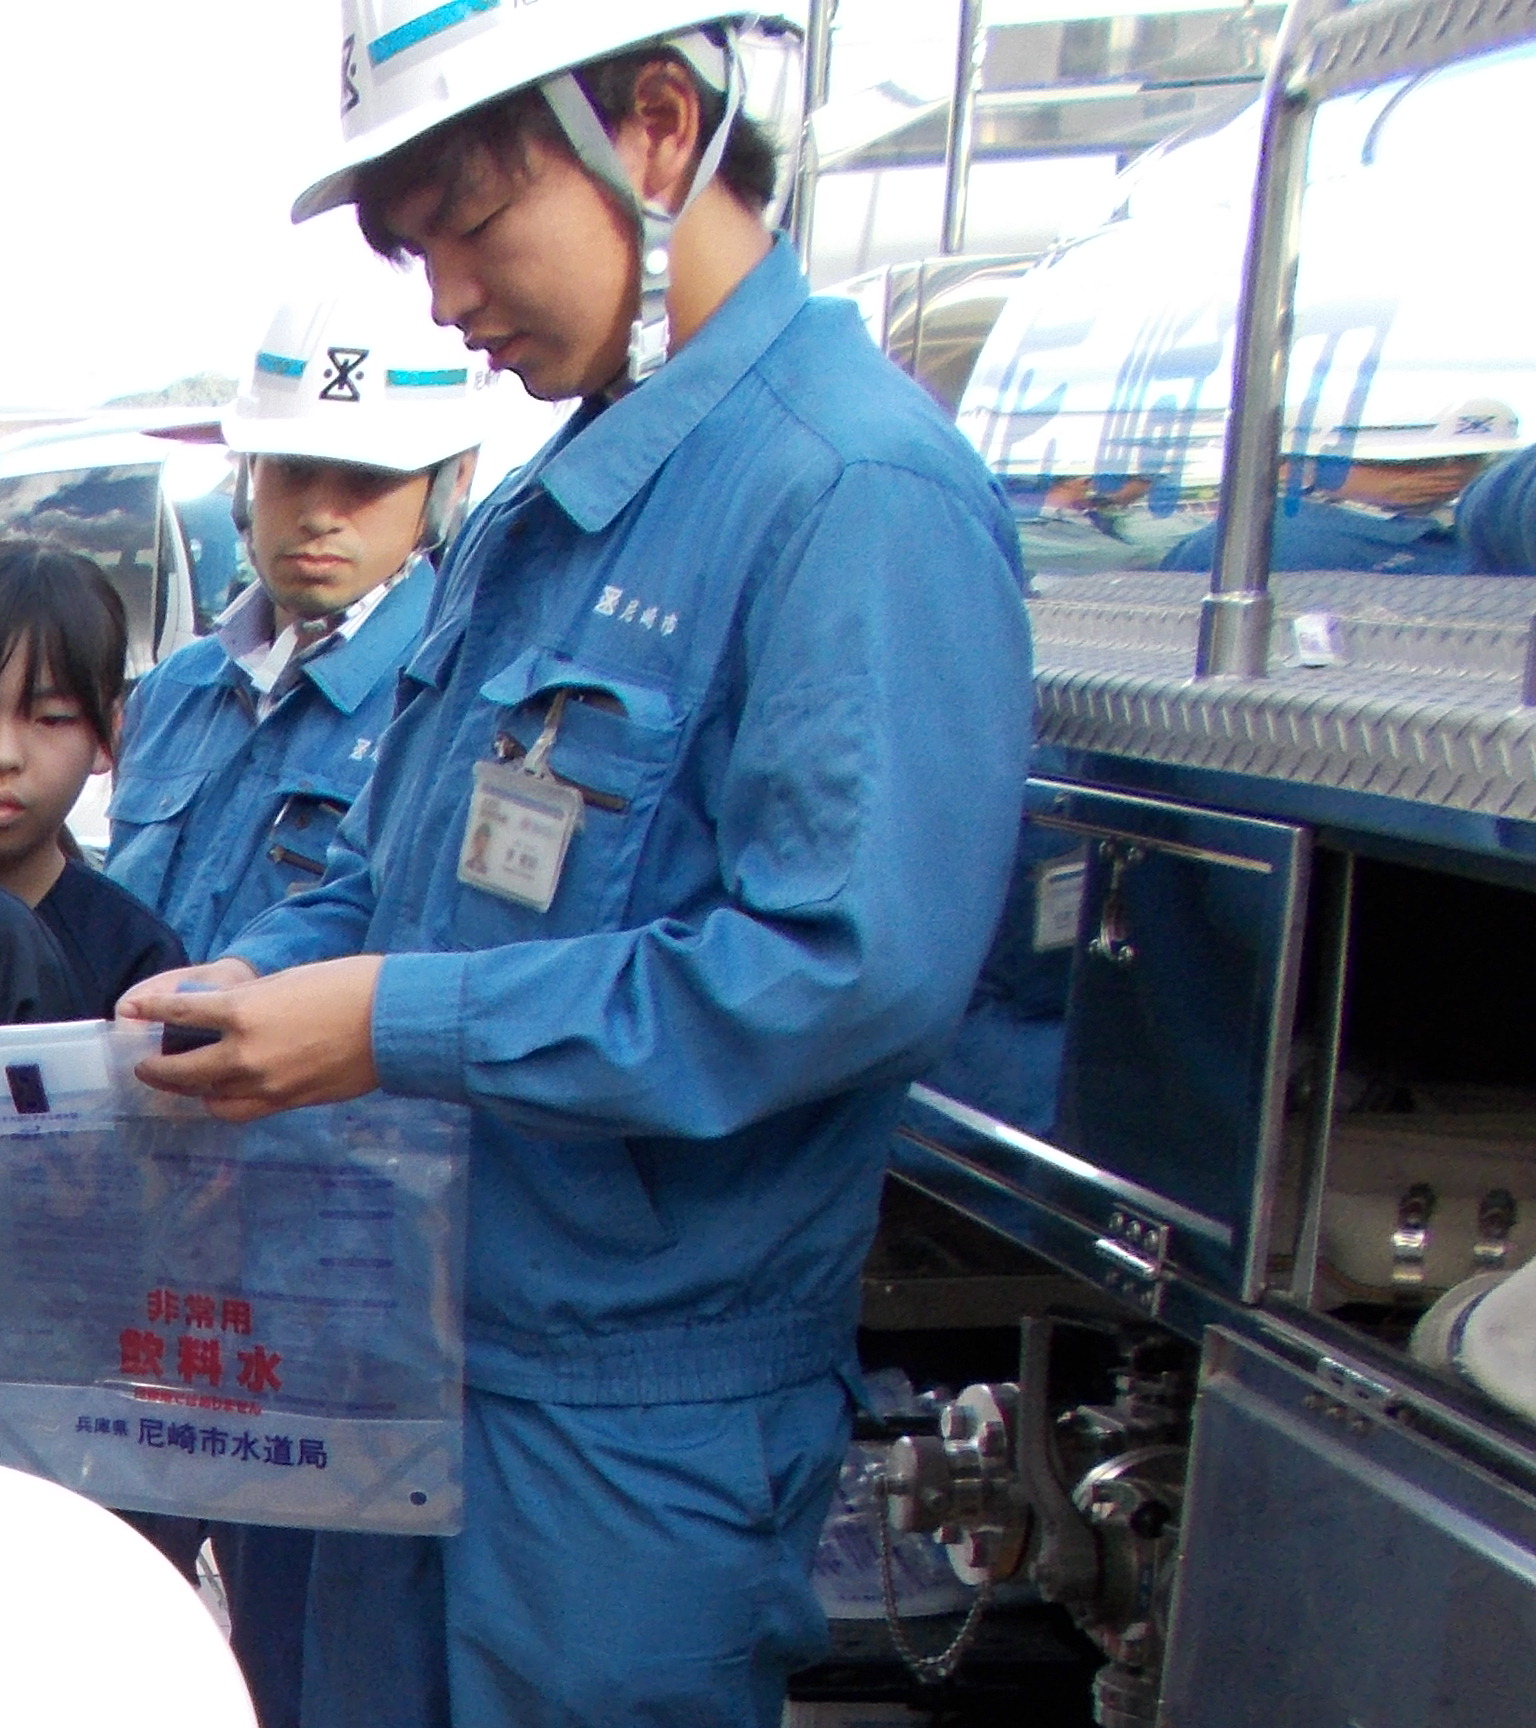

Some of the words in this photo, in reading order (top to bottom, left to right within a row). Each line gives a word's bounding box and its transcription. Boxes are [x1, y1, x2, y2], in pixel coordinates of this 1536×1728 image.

[146, 1288, 253, 1334] 非常用
[118, 1328, 283, 1392] 飲料水
[75, 1417, 129, 1436] 兵庫県
[138, 1417, 328, 1470] 尼崎市水道局
